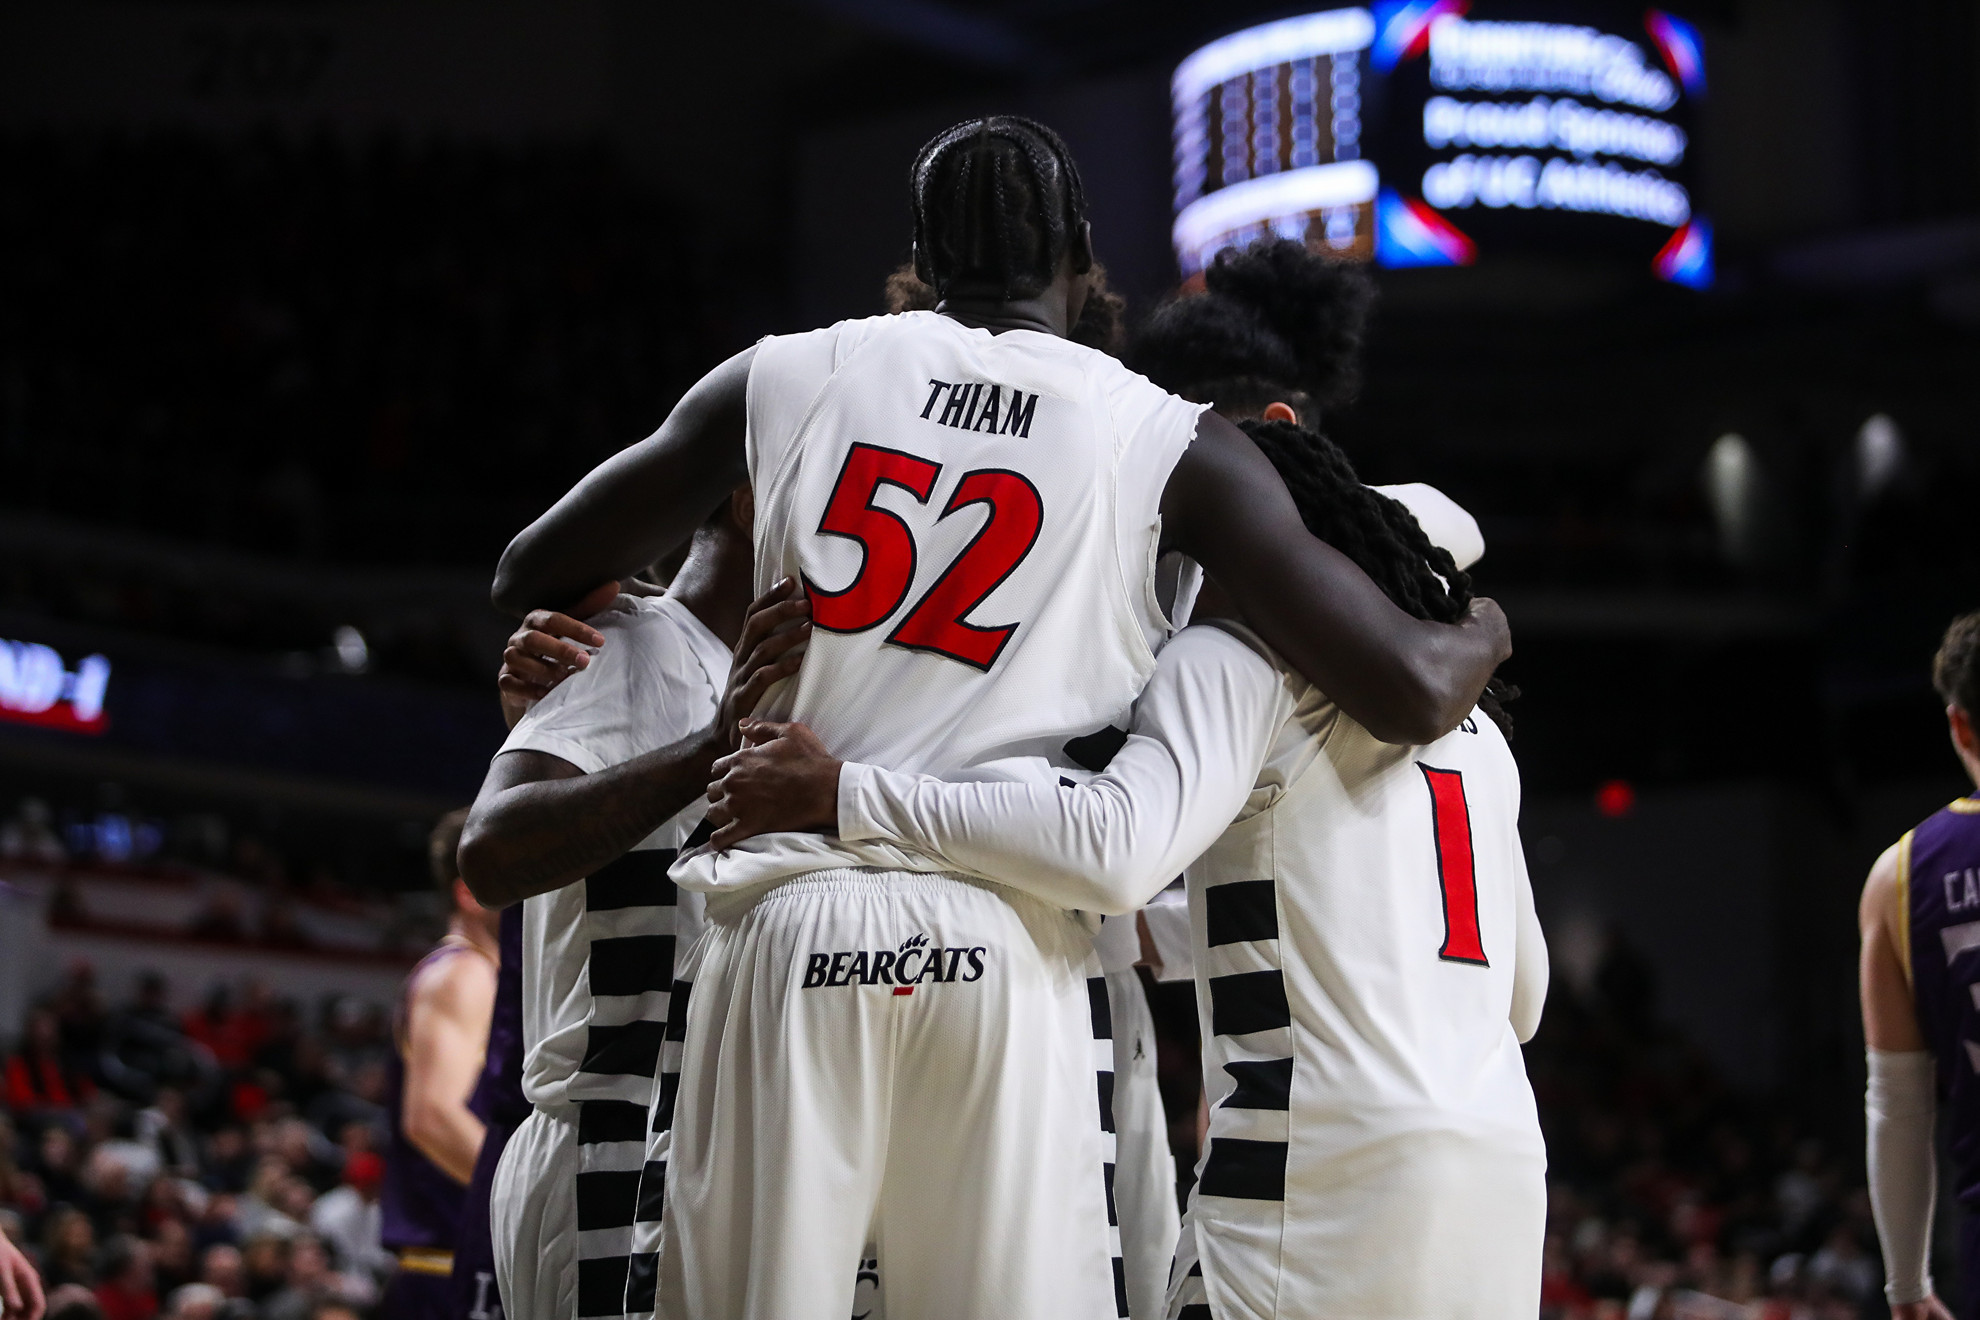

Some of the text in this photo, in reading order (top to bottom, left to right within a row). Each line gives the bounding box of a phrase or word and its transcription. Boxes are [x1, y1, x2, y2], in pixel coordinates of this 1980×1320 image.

[920, 379, 1039, 438] THIAM
[800, 441, 1044, 674] 52
[1415, 761, 1490, 967] 1
[802, 936, 986, 989] BEARCATS
